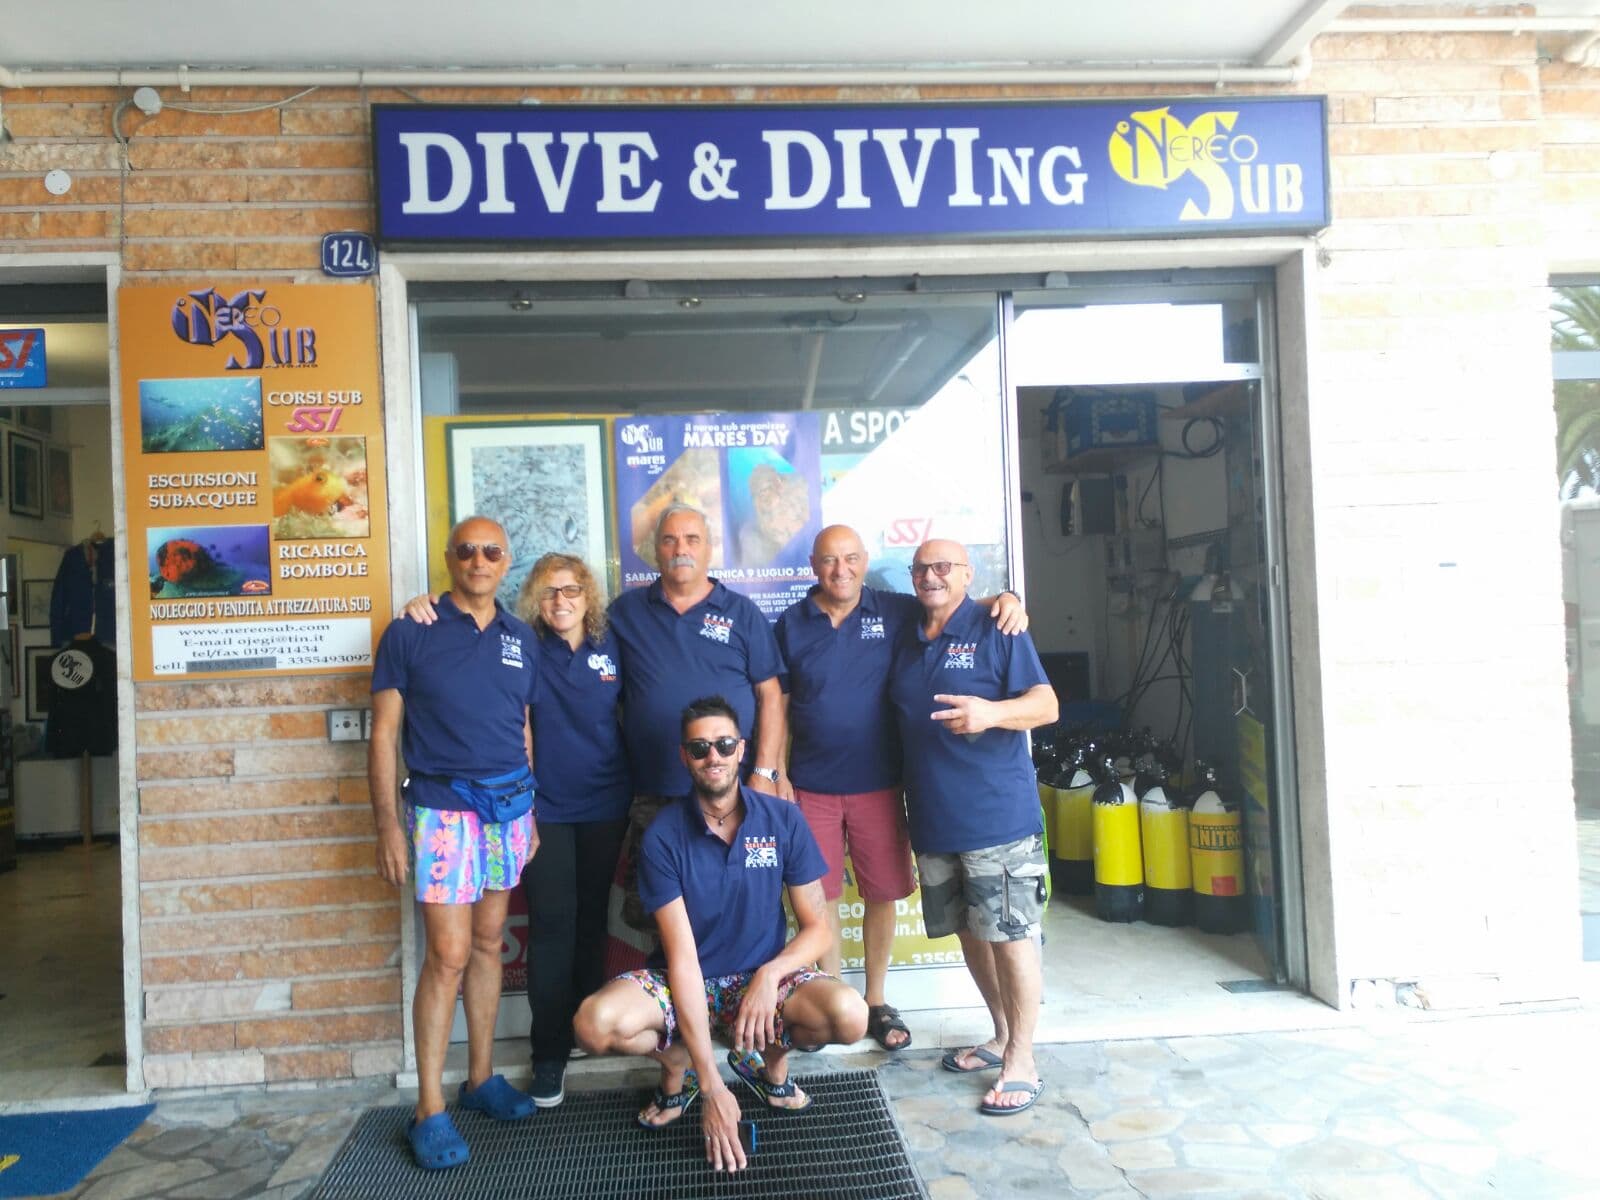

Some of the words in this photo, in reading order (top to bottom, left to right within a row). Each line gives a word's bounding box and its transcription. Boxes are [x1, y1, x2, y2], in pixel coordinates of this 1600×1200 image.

[398, 131, 664, 215] DIVE
[688, 141, 740, 201] &
[761, 125, 1090, 212] DIVING
[330, 239, 370, 270] 124
[0, 332, 37, 370] SI
[267, 392, 324, 406] CORSI
[327, 390, 364, 405] SUB
[284, 406, 344, 433] SSI
[823, 411, 844, 445] A
[683, 431, 747, 448] MARES
[752, 429, 790, 447] DAY
[626, 454, 666, 467] mares
[148, 472, 258, 489] ESCURSIONI
[148, 491, 258, 510] SUBACQUEE
[278, 543, 368, 559] RICARICA
[279, 562, 369, 579] BOMBOLE
[756, 567, 794, 577] LUGLIO
[150, 602, 206, 620] NOLEGGIO
[208, 602, 215, 617] E
[216, 600, 265, 618] VENDITA
[265, 597, 349, 616] ATTREZZATURA
[350, 596, 372, 612] SUB
[179, 624, 331, 637] www.nereosub.com
[183, 638, 232, 648] E-mail
[154, 662, 185, 671] cell.
[744, 836, 776, 844] TEAM
